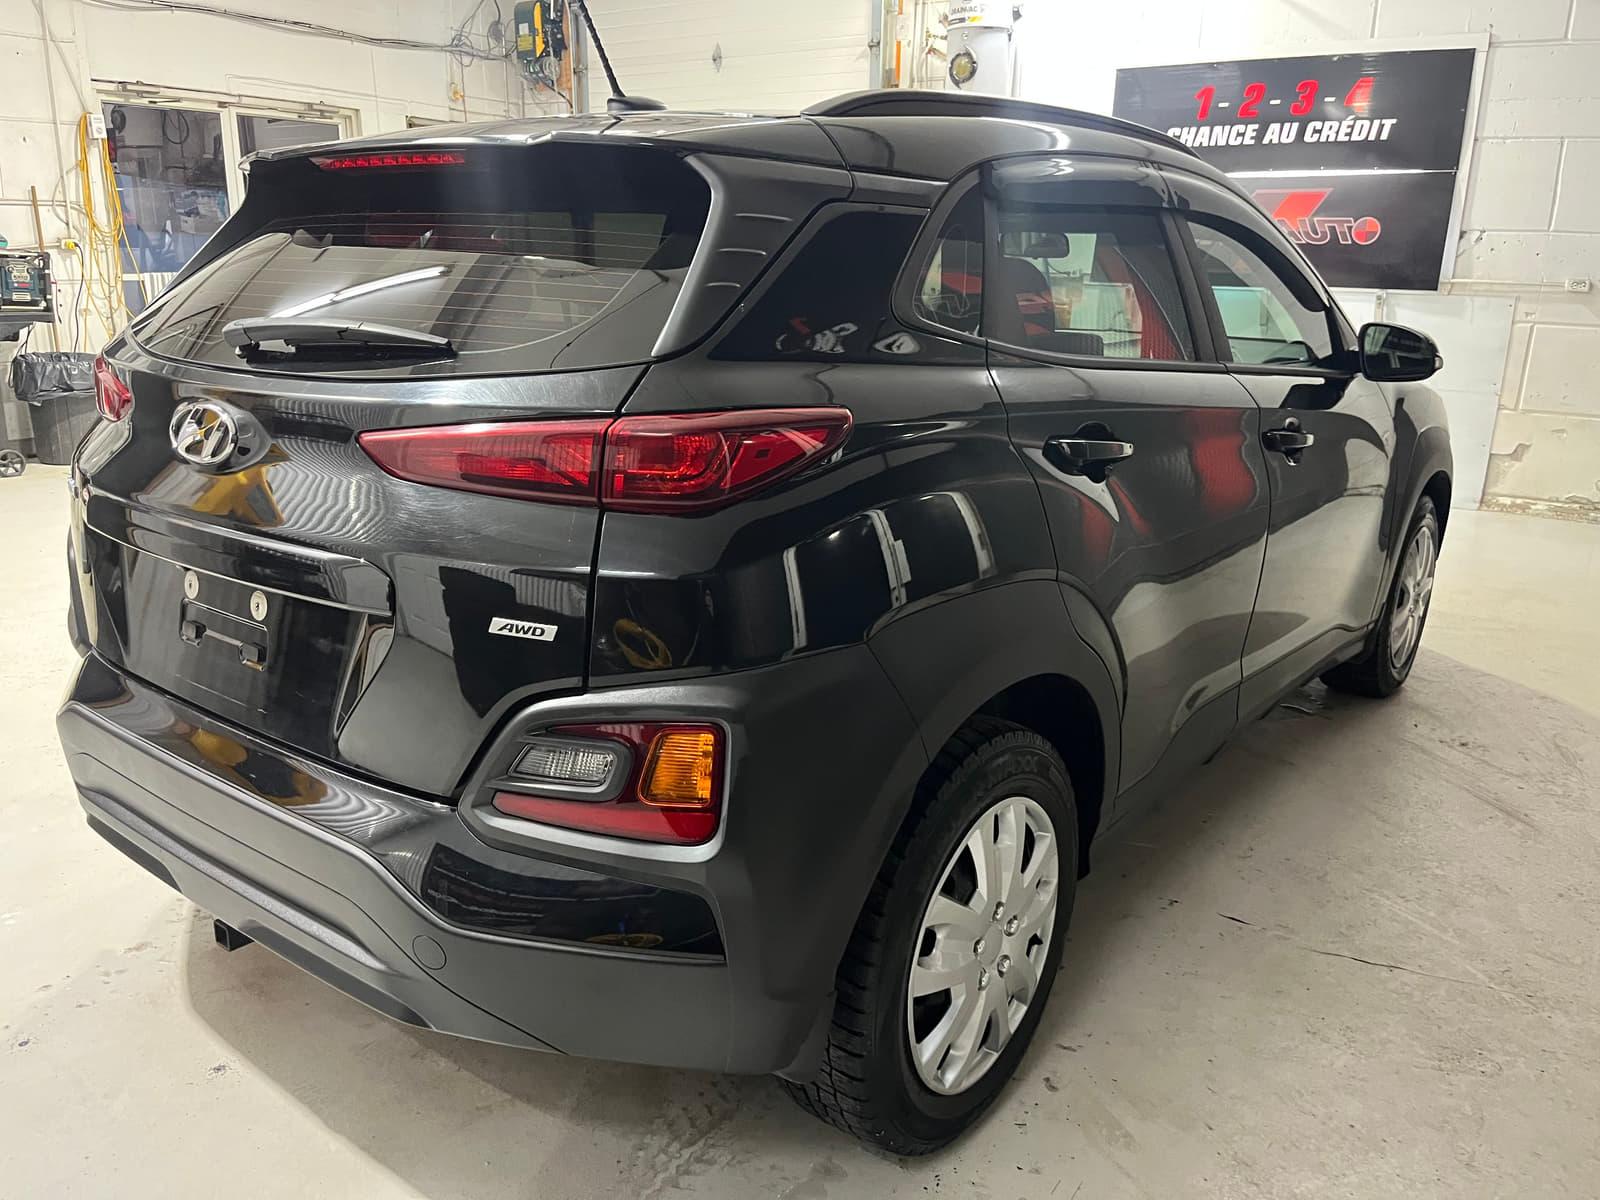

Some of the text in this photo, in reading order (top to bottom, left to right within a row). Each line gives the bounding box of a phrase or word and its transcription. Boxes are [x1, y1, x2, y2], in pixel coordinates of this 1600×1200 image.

[1167, 115, 1397, 147] CHANCE AU CRÉDIT
[497, 623, 546, 637] AWD
